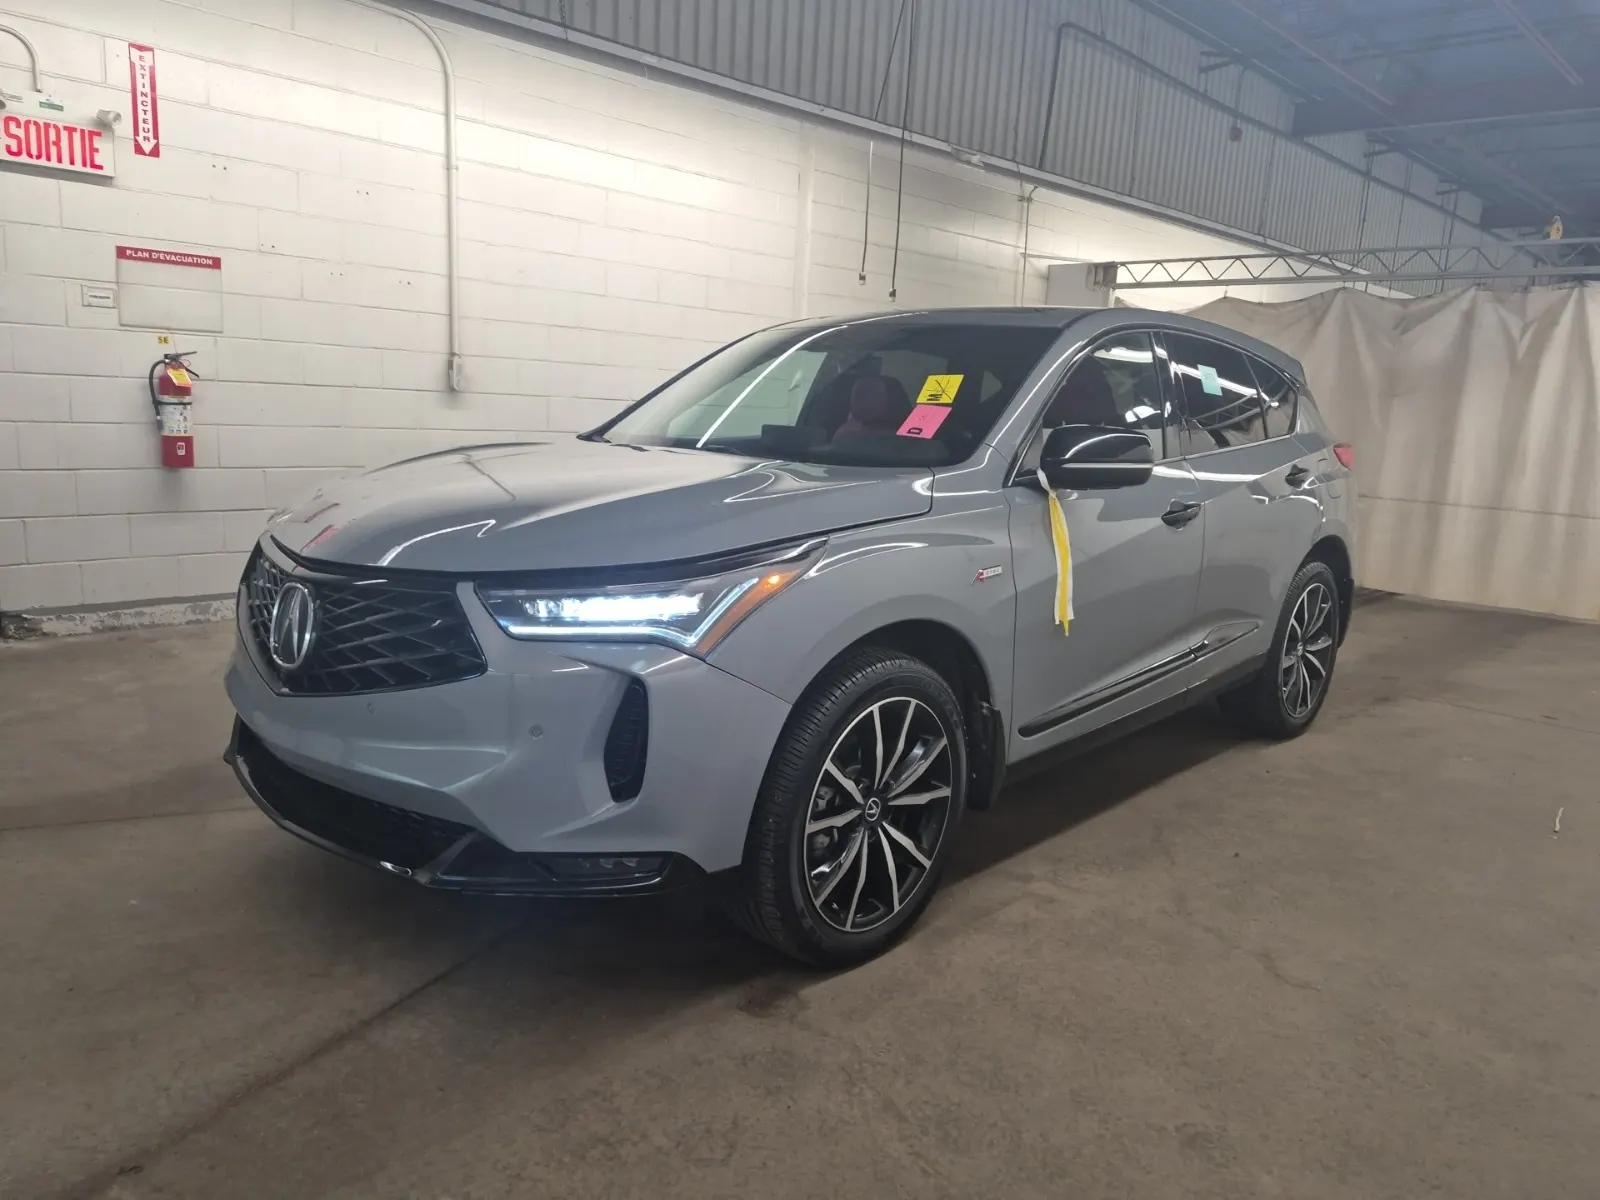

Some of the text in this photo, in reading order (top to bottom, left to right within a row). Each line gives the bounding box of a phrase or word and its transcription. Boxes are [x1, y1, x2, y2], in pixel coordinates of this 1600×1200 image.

[138, 54, 151, 143] EXTINCTEUR
[3, 115, 104, 171] SORTIE
[126, 249, 213, 265] PLAN D'ÉVACUATION
